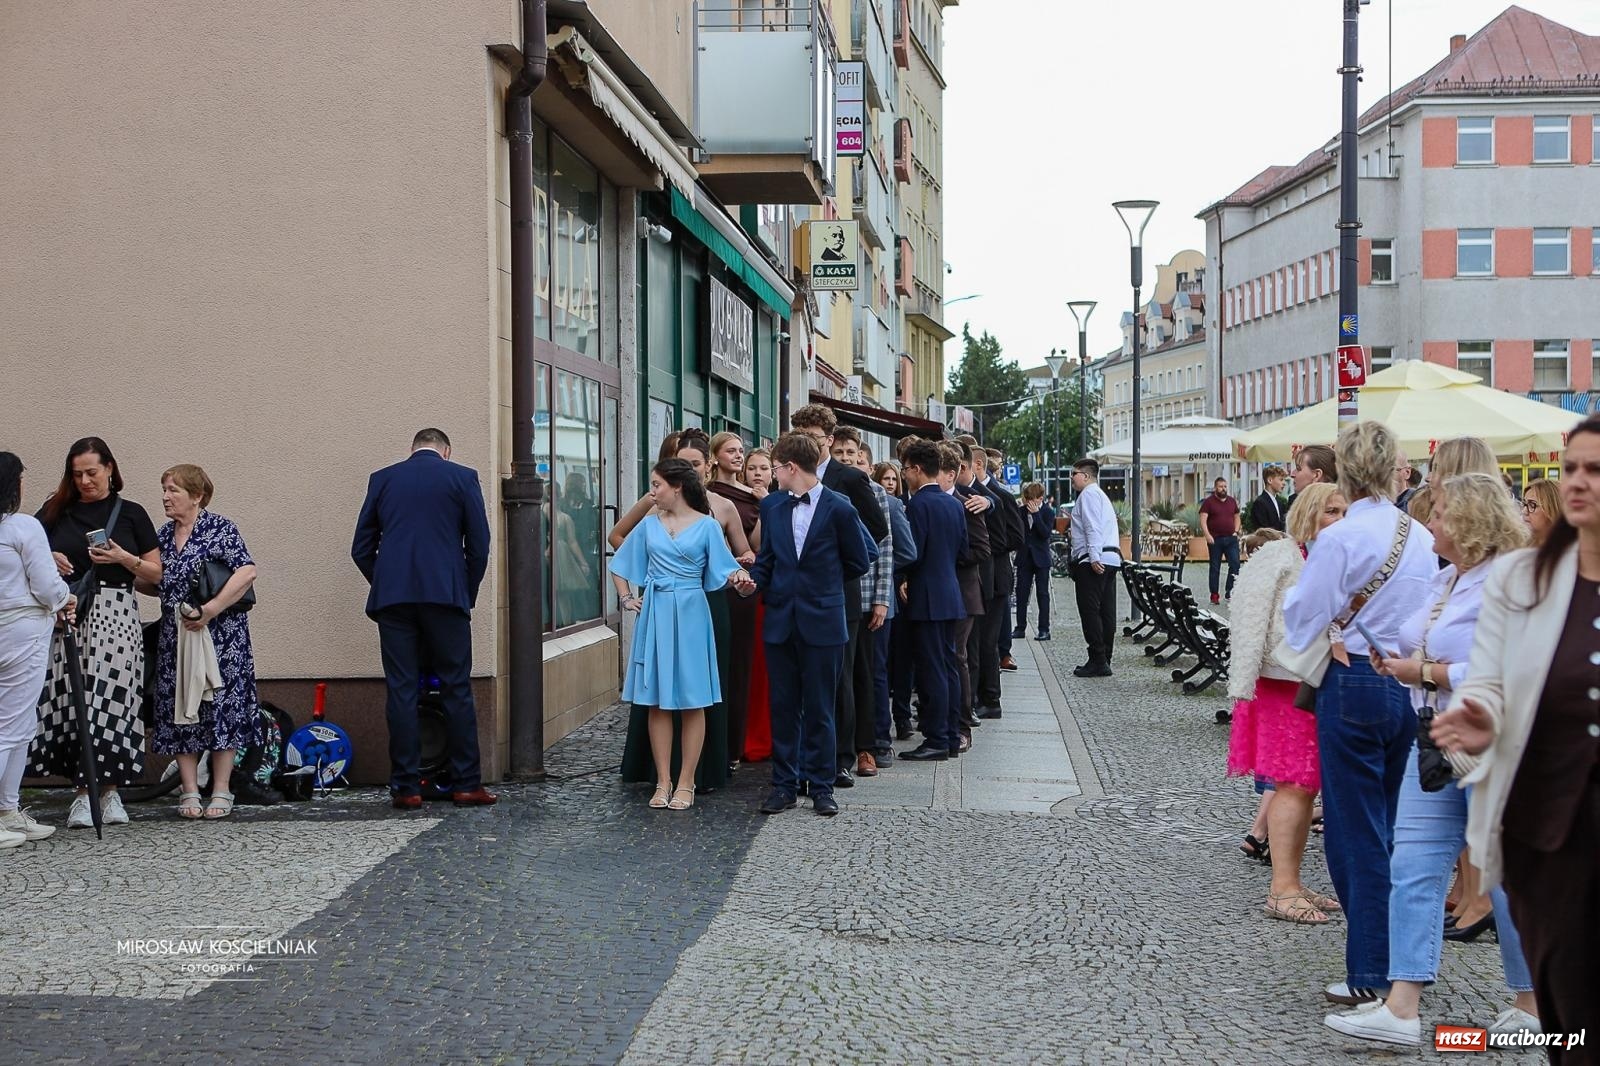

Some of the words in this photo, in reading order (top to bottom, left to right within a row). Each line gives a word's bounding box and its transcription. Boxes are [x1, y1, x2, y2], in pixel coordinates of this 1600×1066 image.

[841, 137, 861, 145] 604
[826, 267, 854, 275] KASY
[814, 278, 854, 286] STEFCZYKA
[710, 282, 753, 355] JUBILER
[1188, 451, 1231, 461] gelatopiu
[1007, 467, 1017, 480] P
